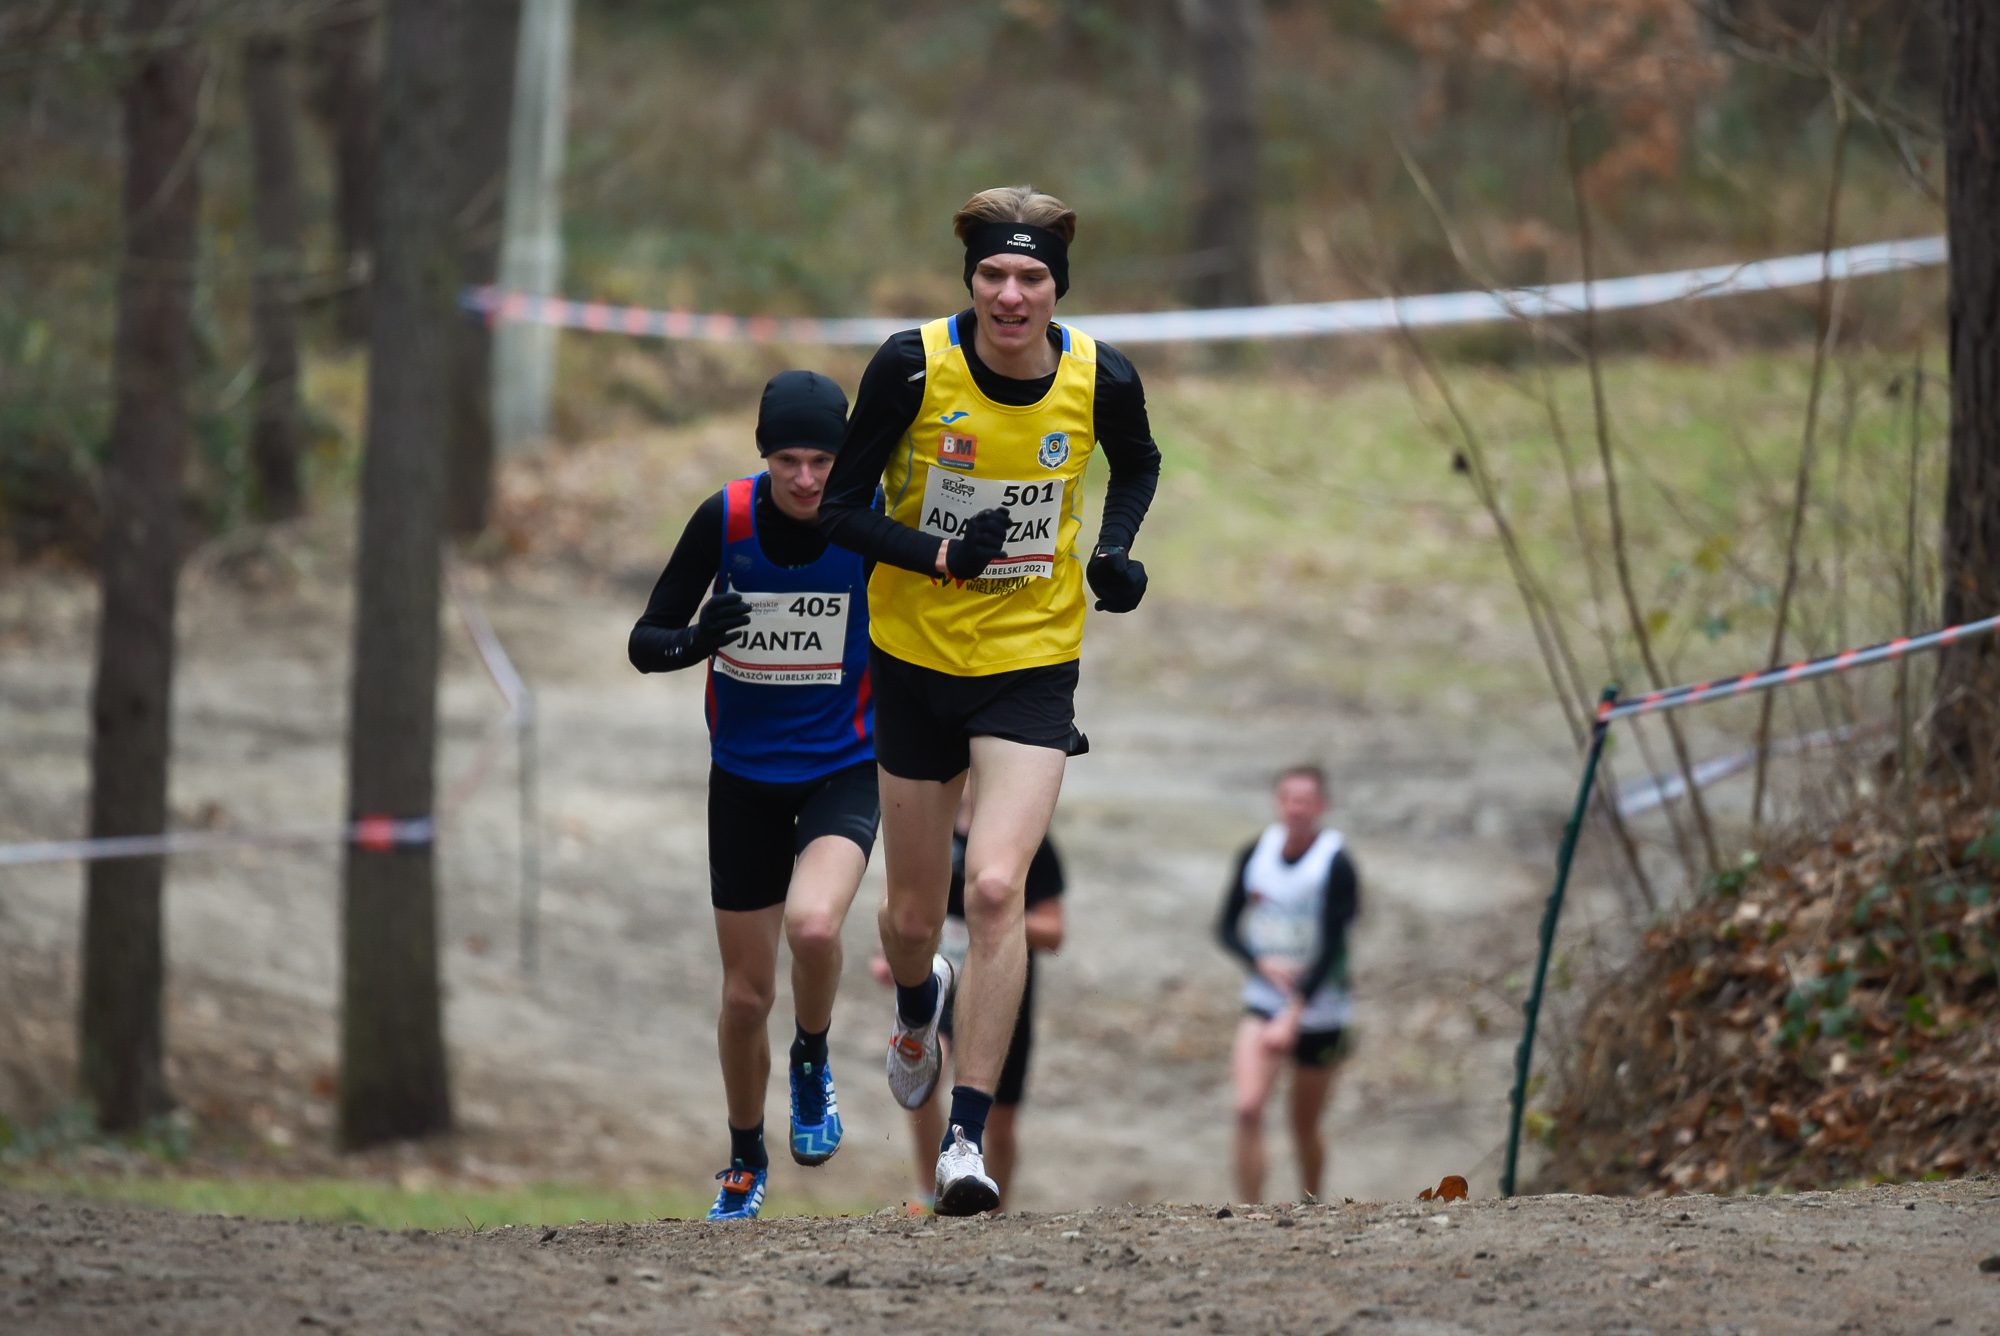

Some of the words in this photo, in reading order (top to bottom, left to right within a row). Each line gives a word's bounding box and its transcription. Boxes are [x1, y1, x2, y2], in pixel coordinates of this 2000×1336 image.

[1006, 240, 1036, 250] Kalenji
[943, 436, 972, 455] BM
[1001, 482, 1053, 506] 501
[926, 507, 1052, 543] ADAZAK
[1023, 564, 1046, 573] 2021
[789, 597, 841, 617] 405
[737, 631, 822, 651] JANTA
[721, 662, 773, 681] TOMASZÓW
[775, 673, 814, 681] LUBELSKI
[816, 672, 837, 680] 2021
